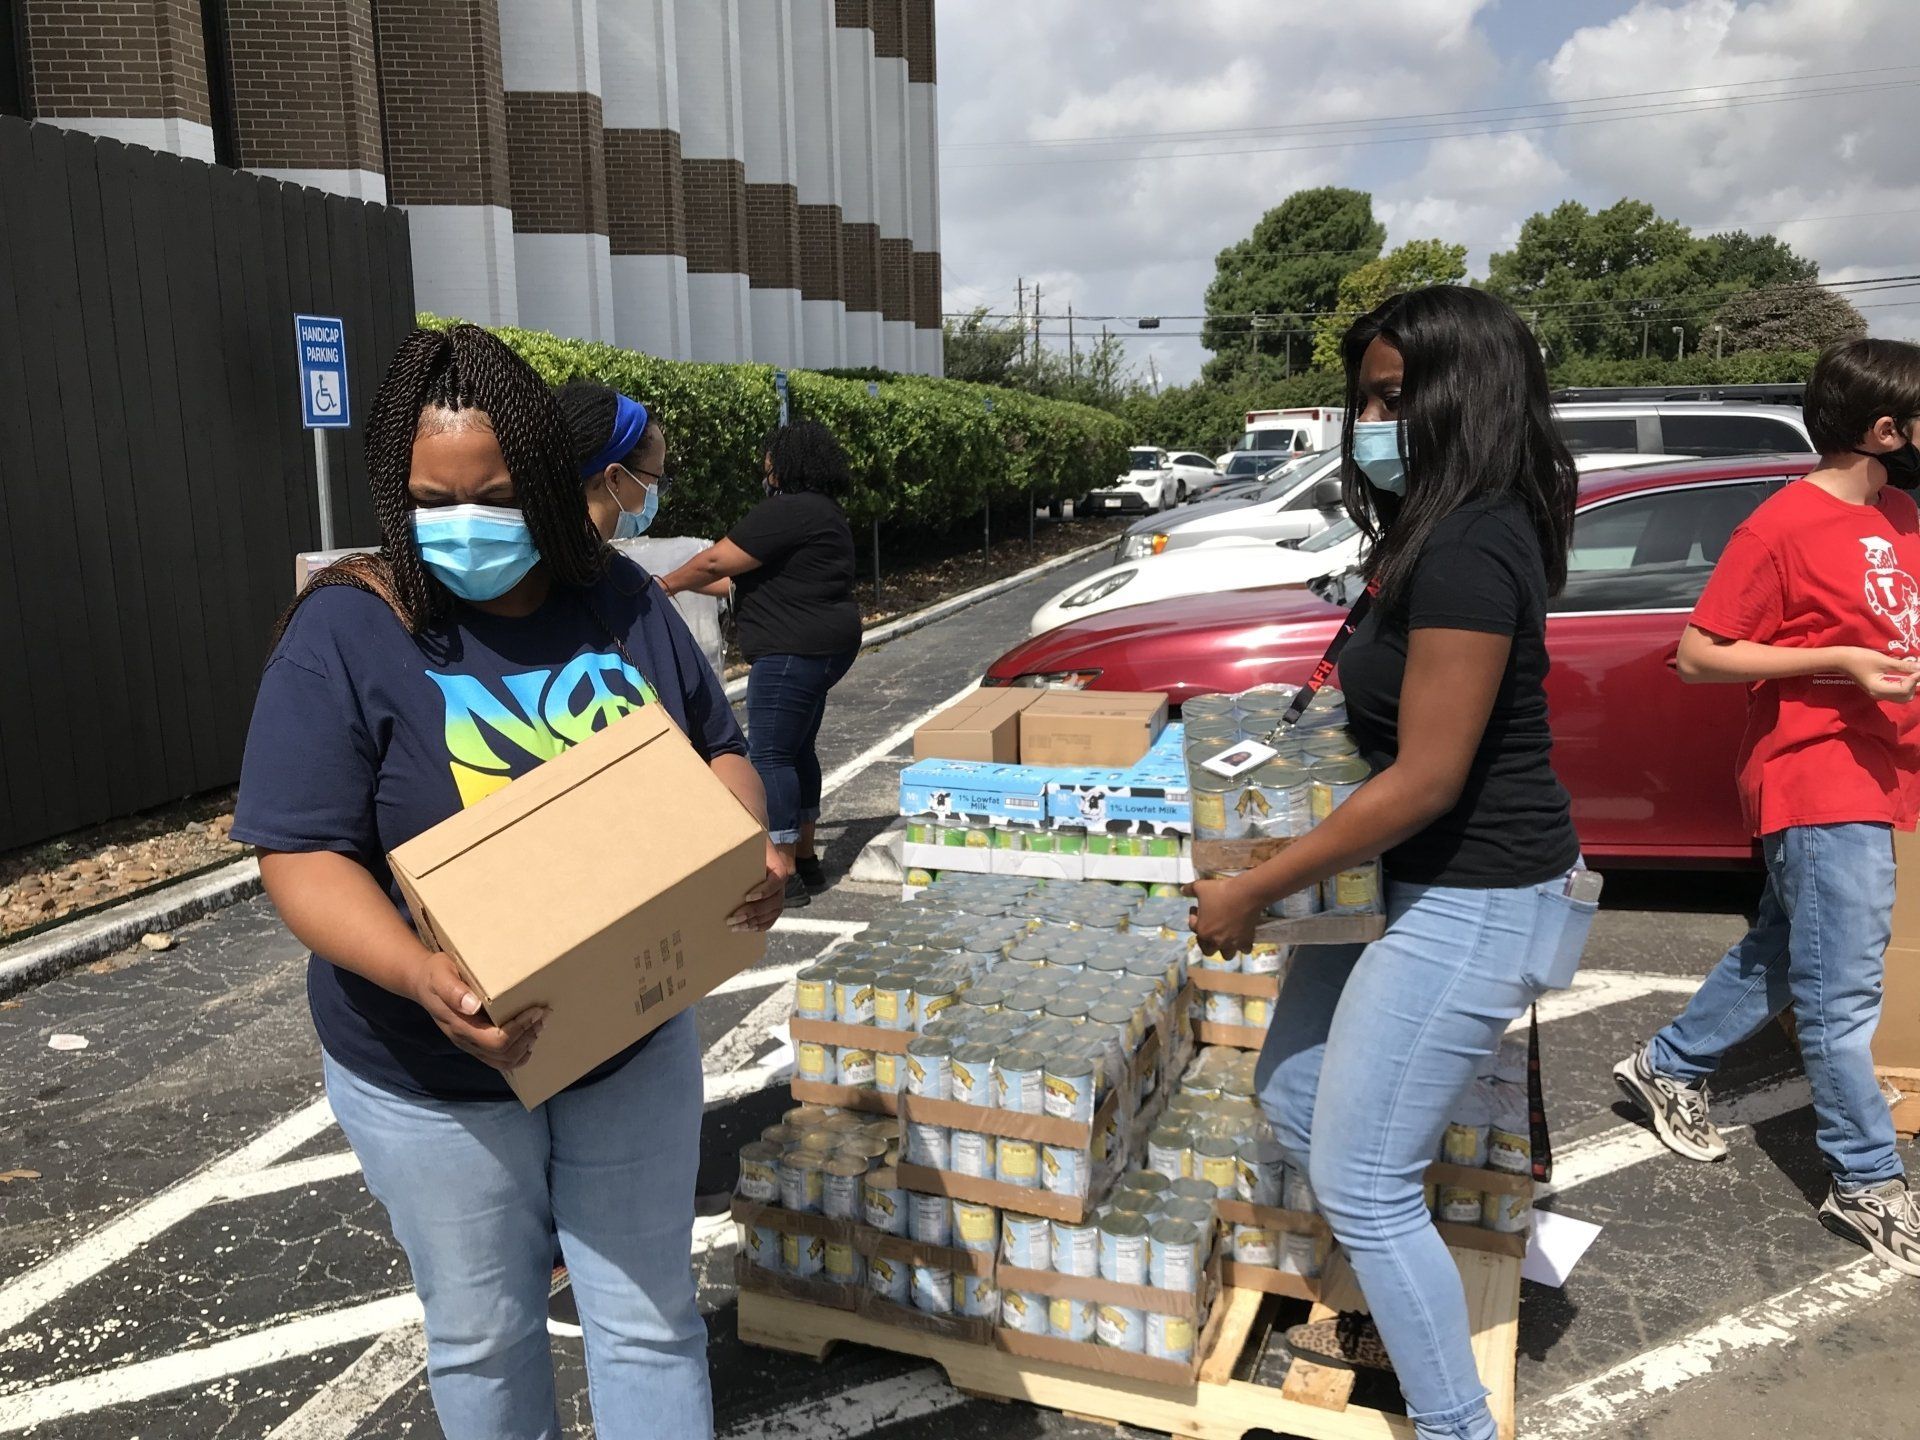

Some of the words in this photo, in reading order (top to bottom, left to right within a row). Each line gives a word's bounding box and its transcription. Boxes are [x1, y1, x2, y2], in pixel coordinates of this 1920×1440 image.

[302, 326, 339, 343] HANDICAP
[306, 346, 339, 362] PARKING
[1876, 577, 1898, 608] T
[1307, 660, 1334, 692] AFH
[959, 794, 969, 802] 1%
[971, 795, 1000, 805] Lowfat
[971, 802, 988, 811] Milk
[1110, 804, 1122, 812] 1%
[1125, 804, 1156, 813] Lowfat
[1159, 805, 1177, 814] Milk
